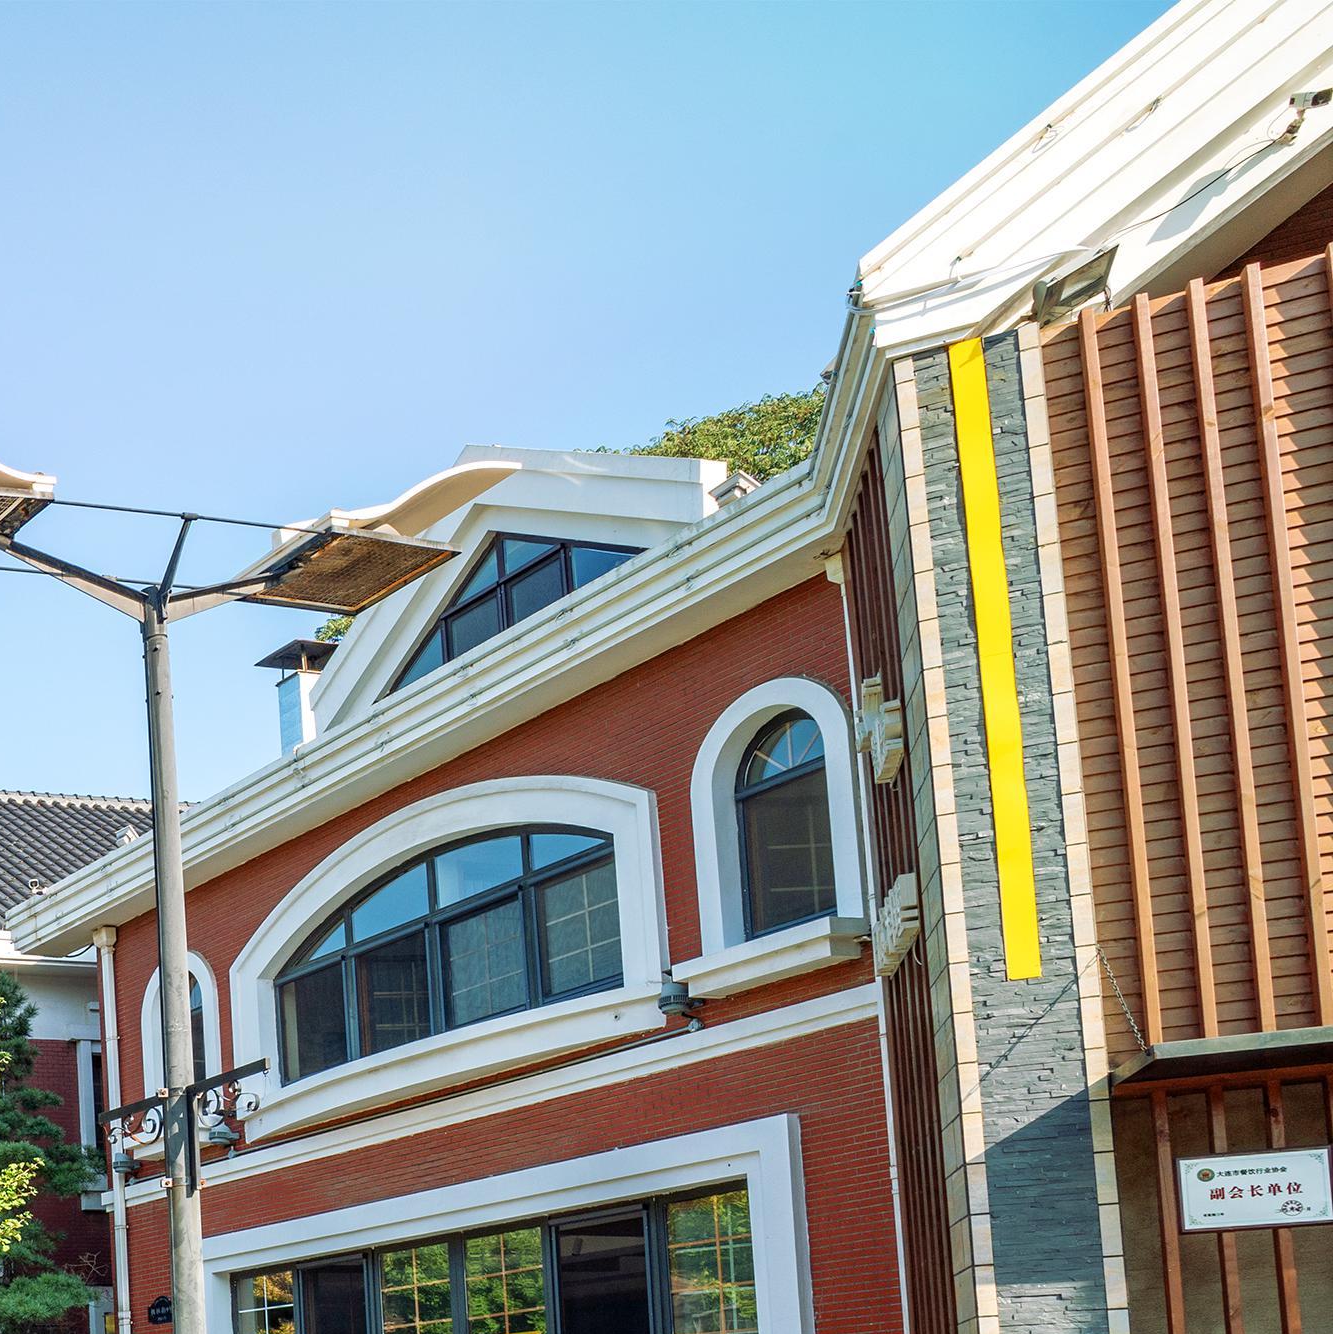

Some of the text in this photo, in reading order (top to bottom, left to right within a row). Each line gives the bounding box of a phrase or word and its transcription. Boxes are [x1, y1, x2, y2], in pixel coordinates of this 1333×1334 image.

[1216, 1166, 1288, 1177] 大连市餐饮行业协会
[1210, 1182, 1304, 1200] 副会长单位
